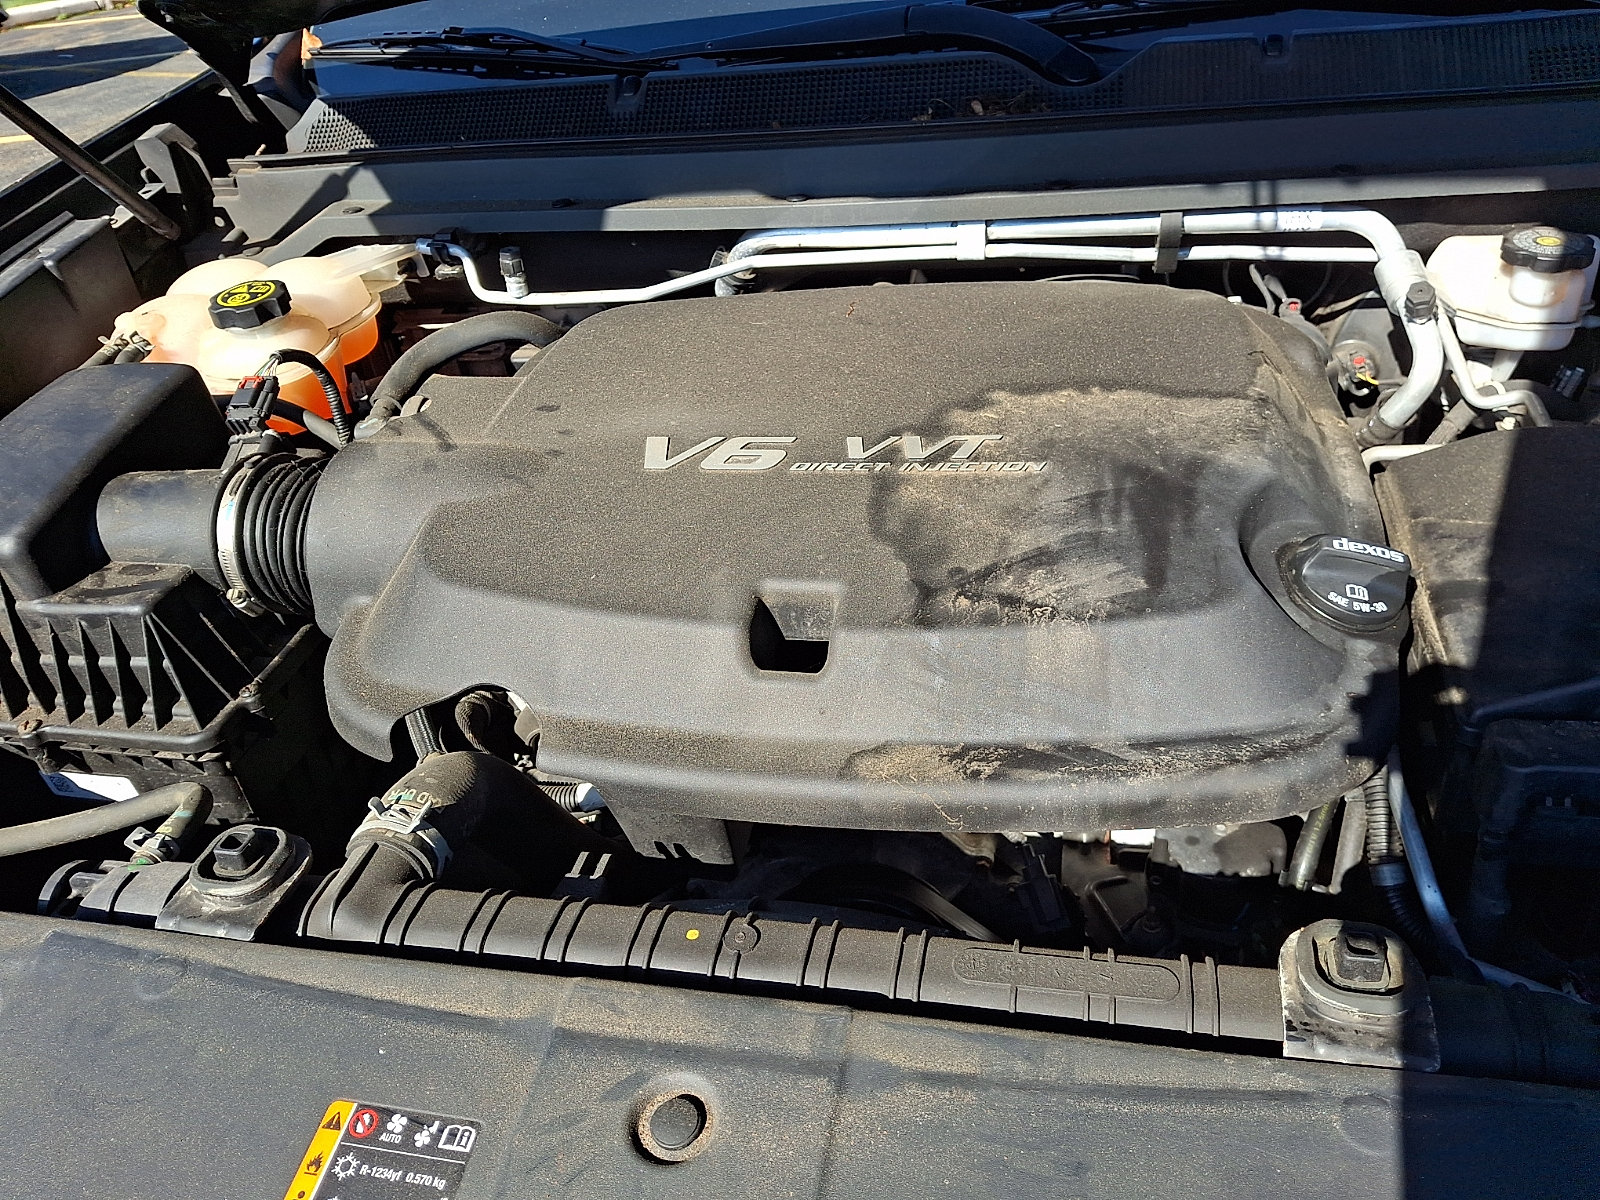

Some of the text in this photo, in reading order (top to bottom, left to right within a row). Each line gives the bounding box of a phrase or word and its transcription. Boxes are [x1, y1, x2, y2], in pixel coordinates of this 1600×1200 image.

[644, 435, 1004, 470] V6 VVT
[789, 461, 1048, 472] DIRECT INJECTION
[1332, 537, 1405, 563] dexos
[1327, 591, 1388, 613] SAE 5W-30
[379, 1133, 402, 1144] AUTO
[359, 1165, 446, 1191] R-1234yf 0.570 kg
